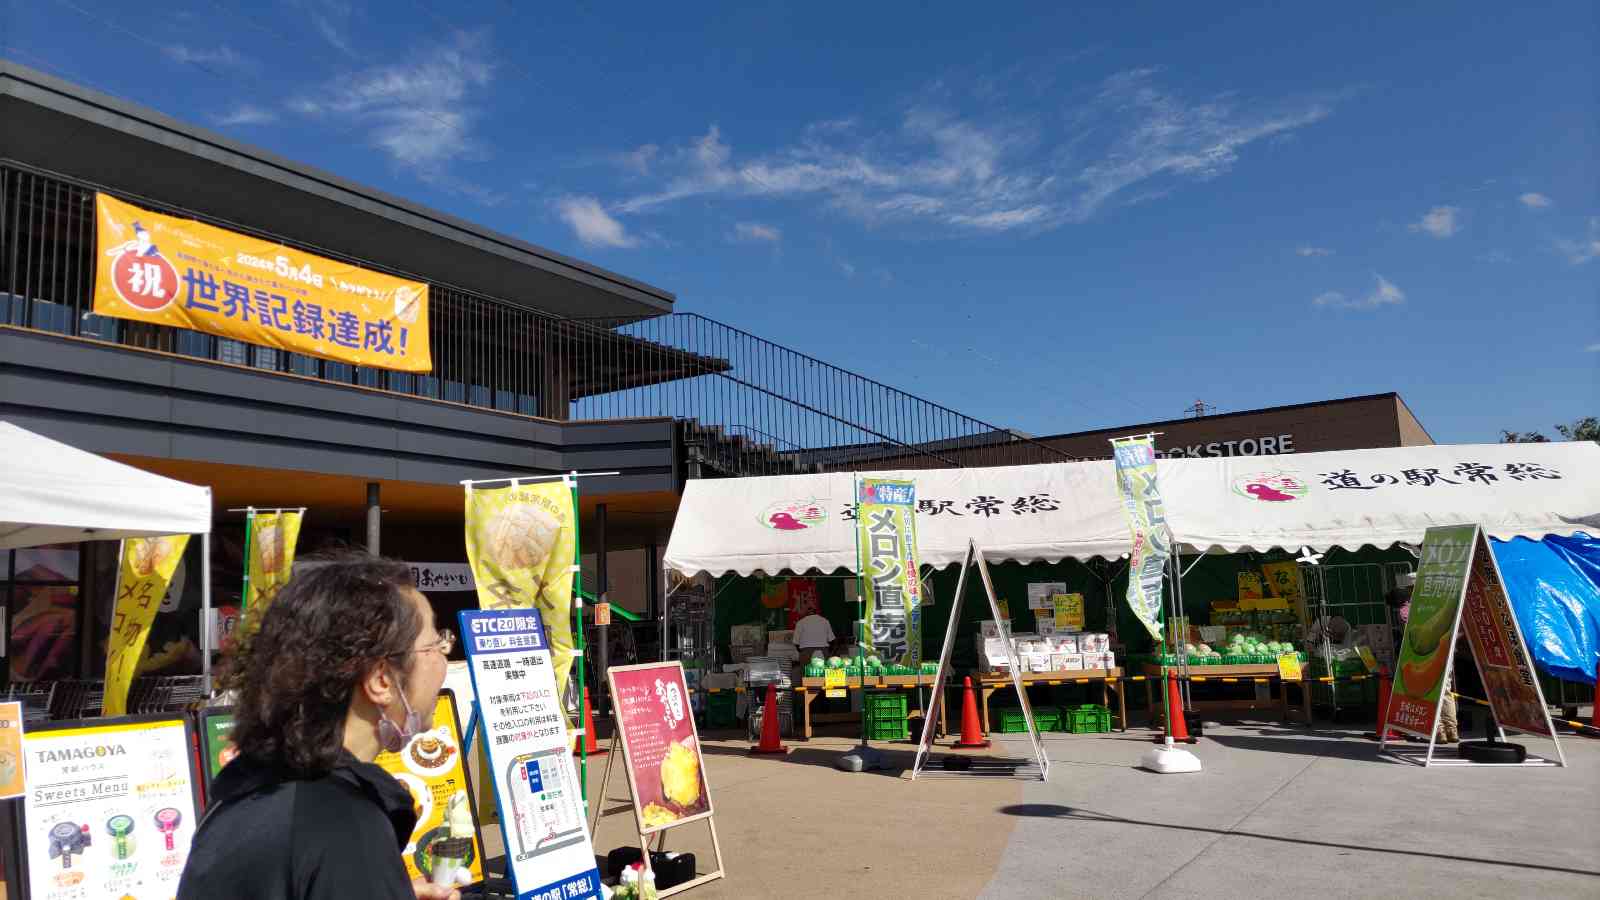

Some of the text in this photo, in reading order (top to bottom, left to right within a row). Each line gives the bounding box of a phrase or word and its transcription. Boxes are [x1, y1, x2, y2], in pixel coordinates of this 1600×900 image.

[128, 262, 165, 299] 祝
[1320, 463, 1562, 490] 道の駅常総
[35, 744, 127, 763] TAMAGOYA
[34, 787, 87, 802] Sweets
[91, 782, 129, 795] Menu
